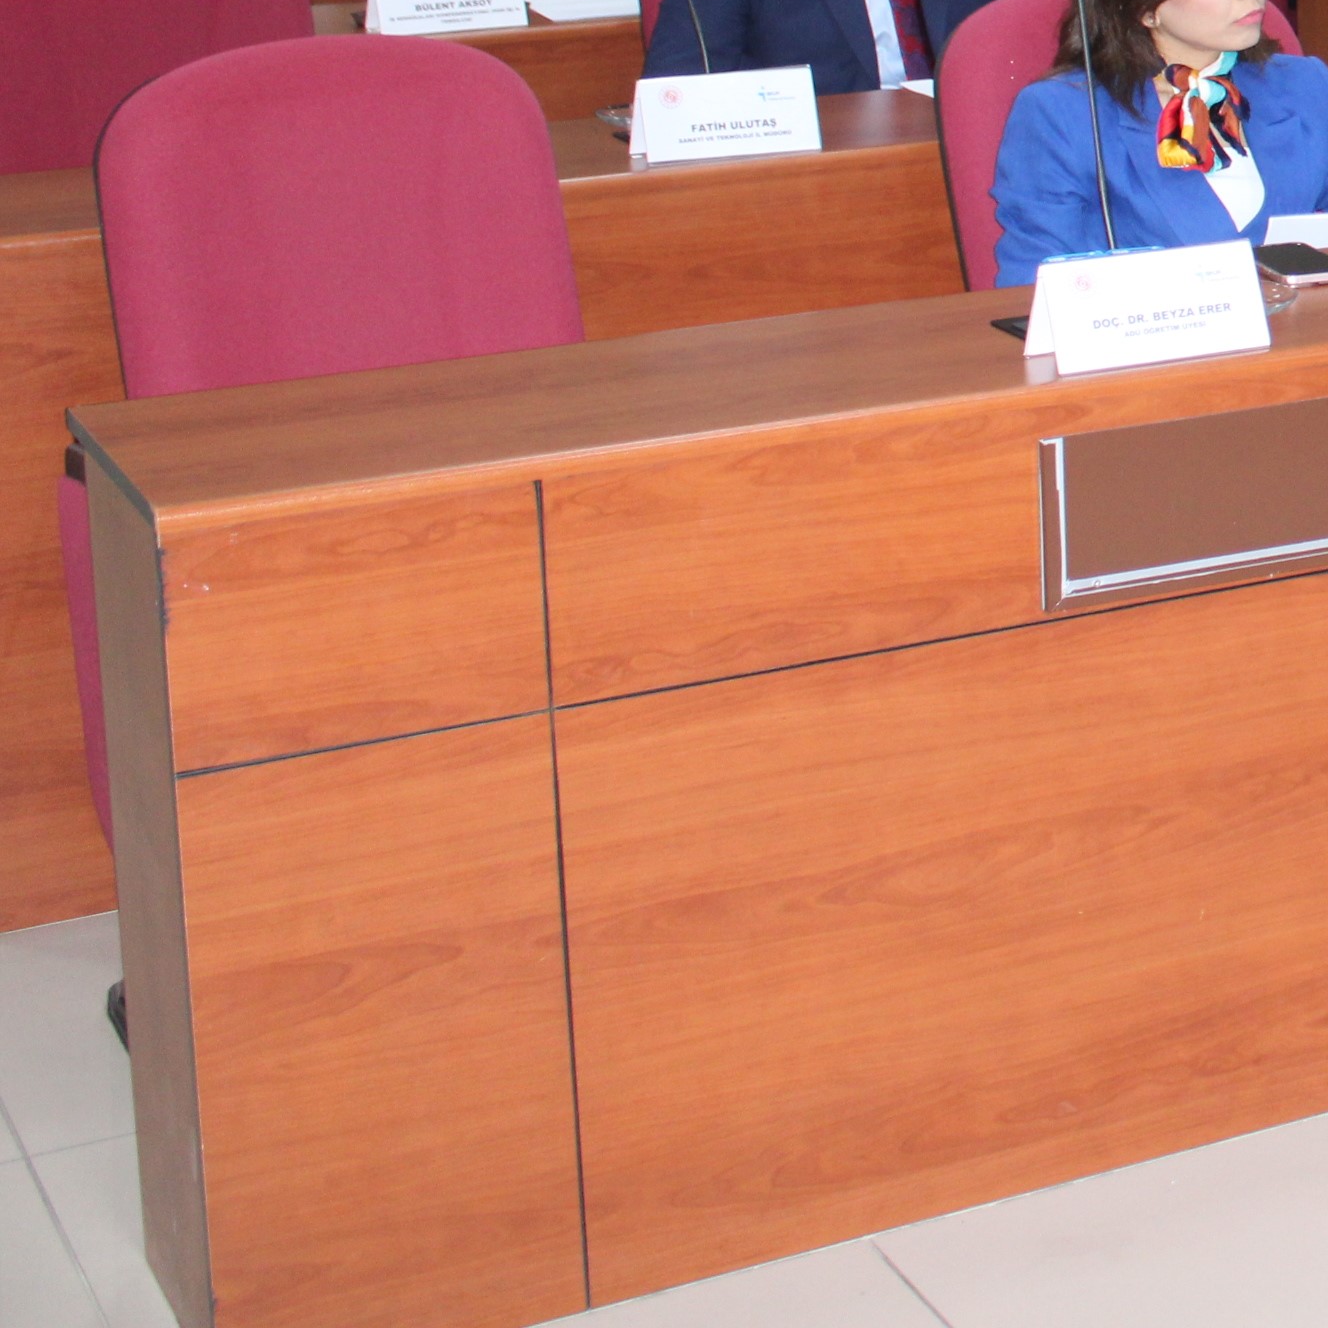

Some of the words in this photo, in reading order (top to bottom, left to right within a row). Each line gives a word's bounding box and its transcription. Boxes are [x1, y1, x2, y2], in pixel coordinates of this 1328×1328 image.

[415, 1, 455, 12] BÜLENT
[458, 0, 492, 9] AKSOY
[691, 121, 727, 133] FATİH
[730, 118, 777, 131] ULUTAŞ
[1093, 317, 1124, 329] DOÇ.
[1128, 314, 1149, 325] DR.
[1153, 307, 1195, 321] BEYZA
[1199, 302, 1232, 316] ERER
